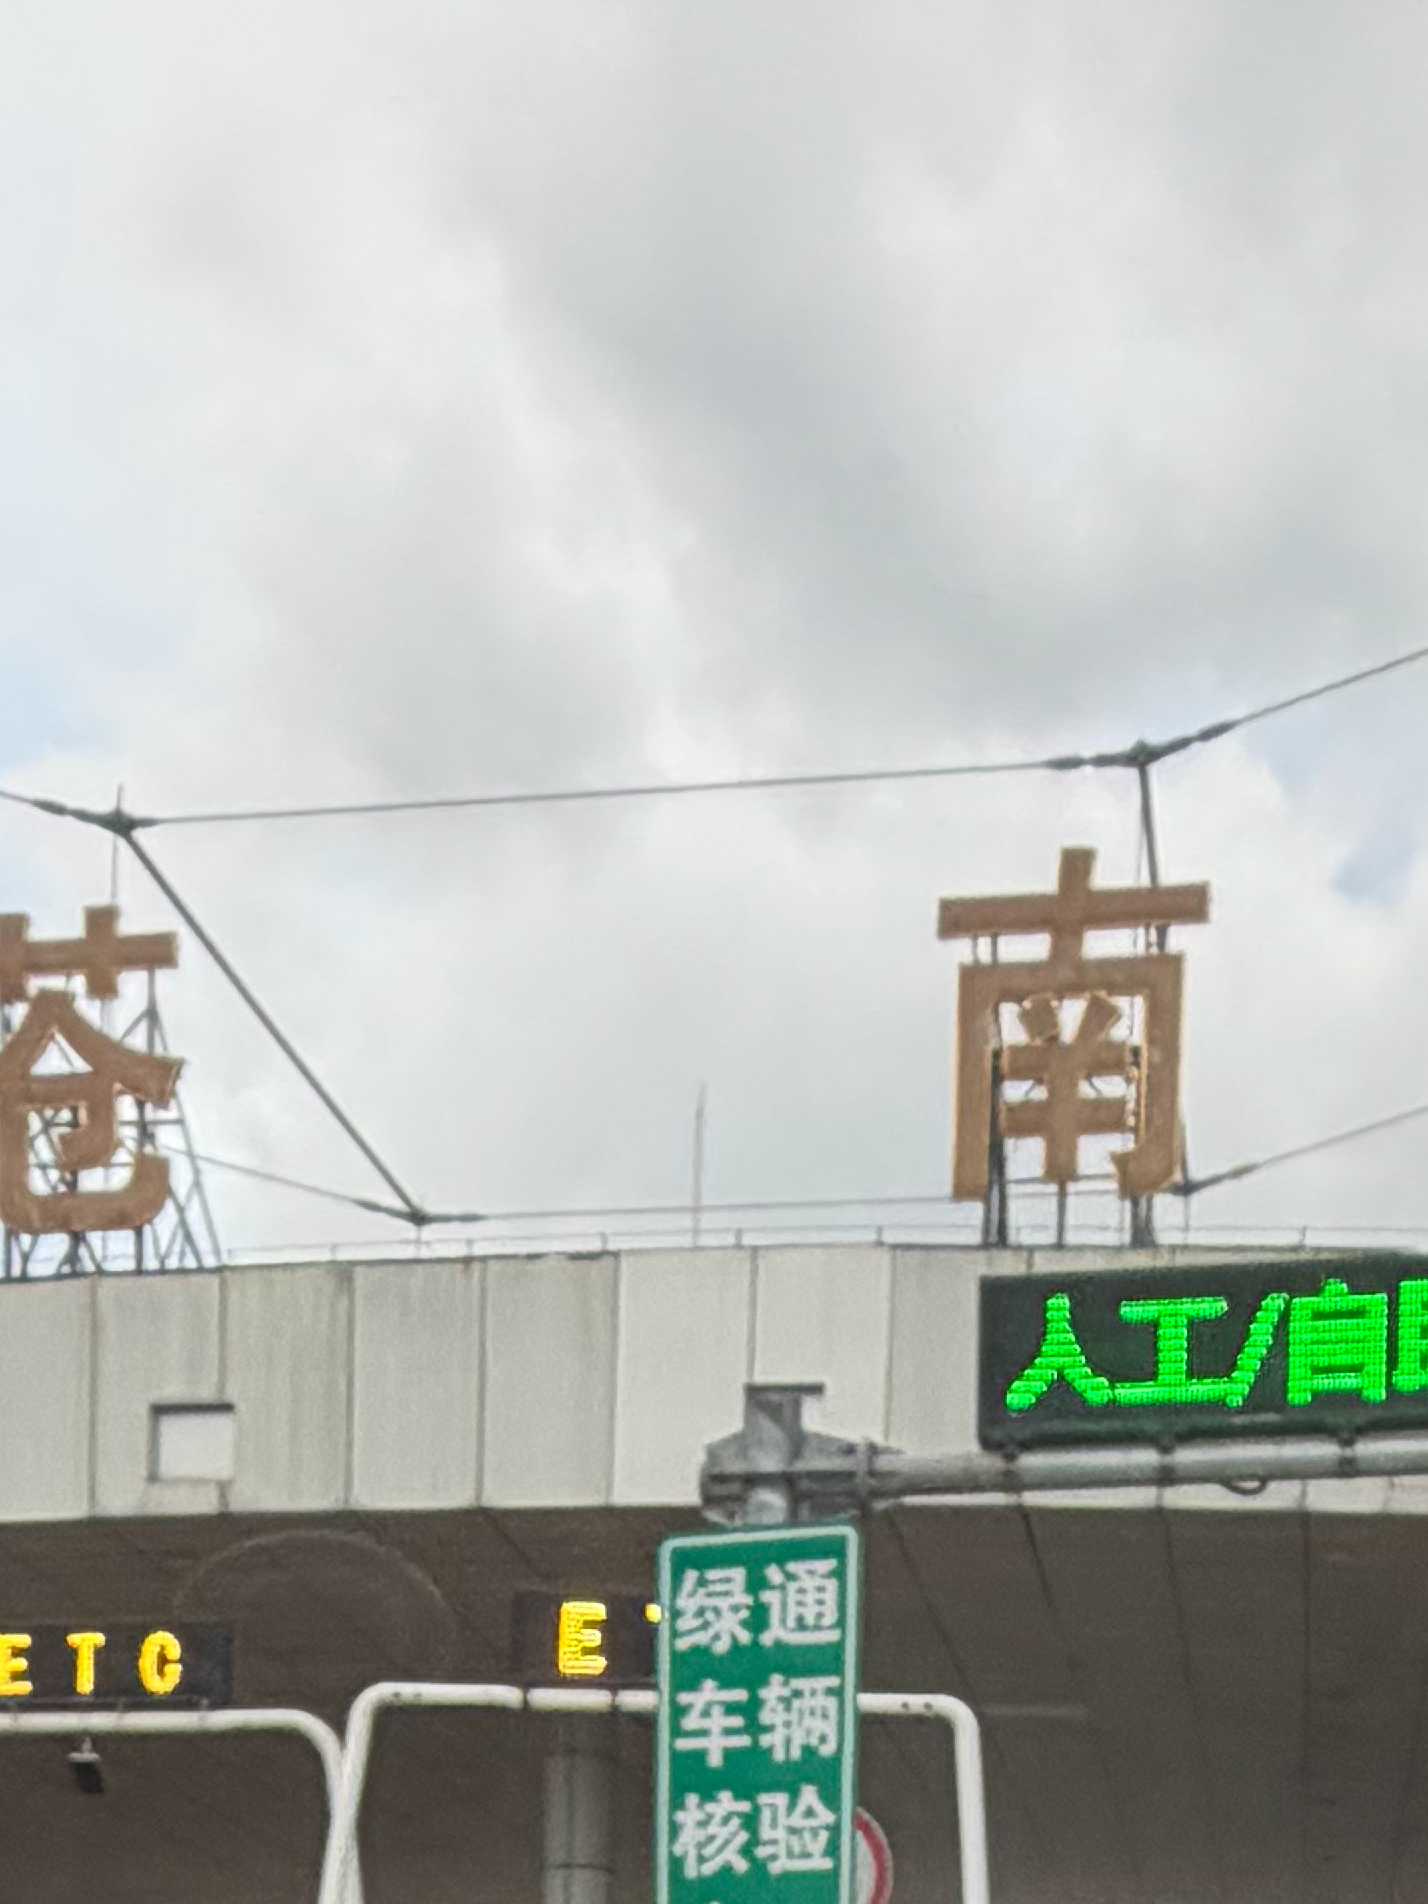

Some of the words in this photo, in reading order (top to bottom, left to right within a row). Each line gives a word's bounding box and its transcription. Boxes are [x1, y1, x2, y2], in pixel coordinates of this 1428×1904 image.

[938, 846, 1212, 1201] 南
[673, 1557, 842, 1655] 绿通
[673, 1673, 842, 1768] 车辆
[673, 1784, 837, 1880] 核验
